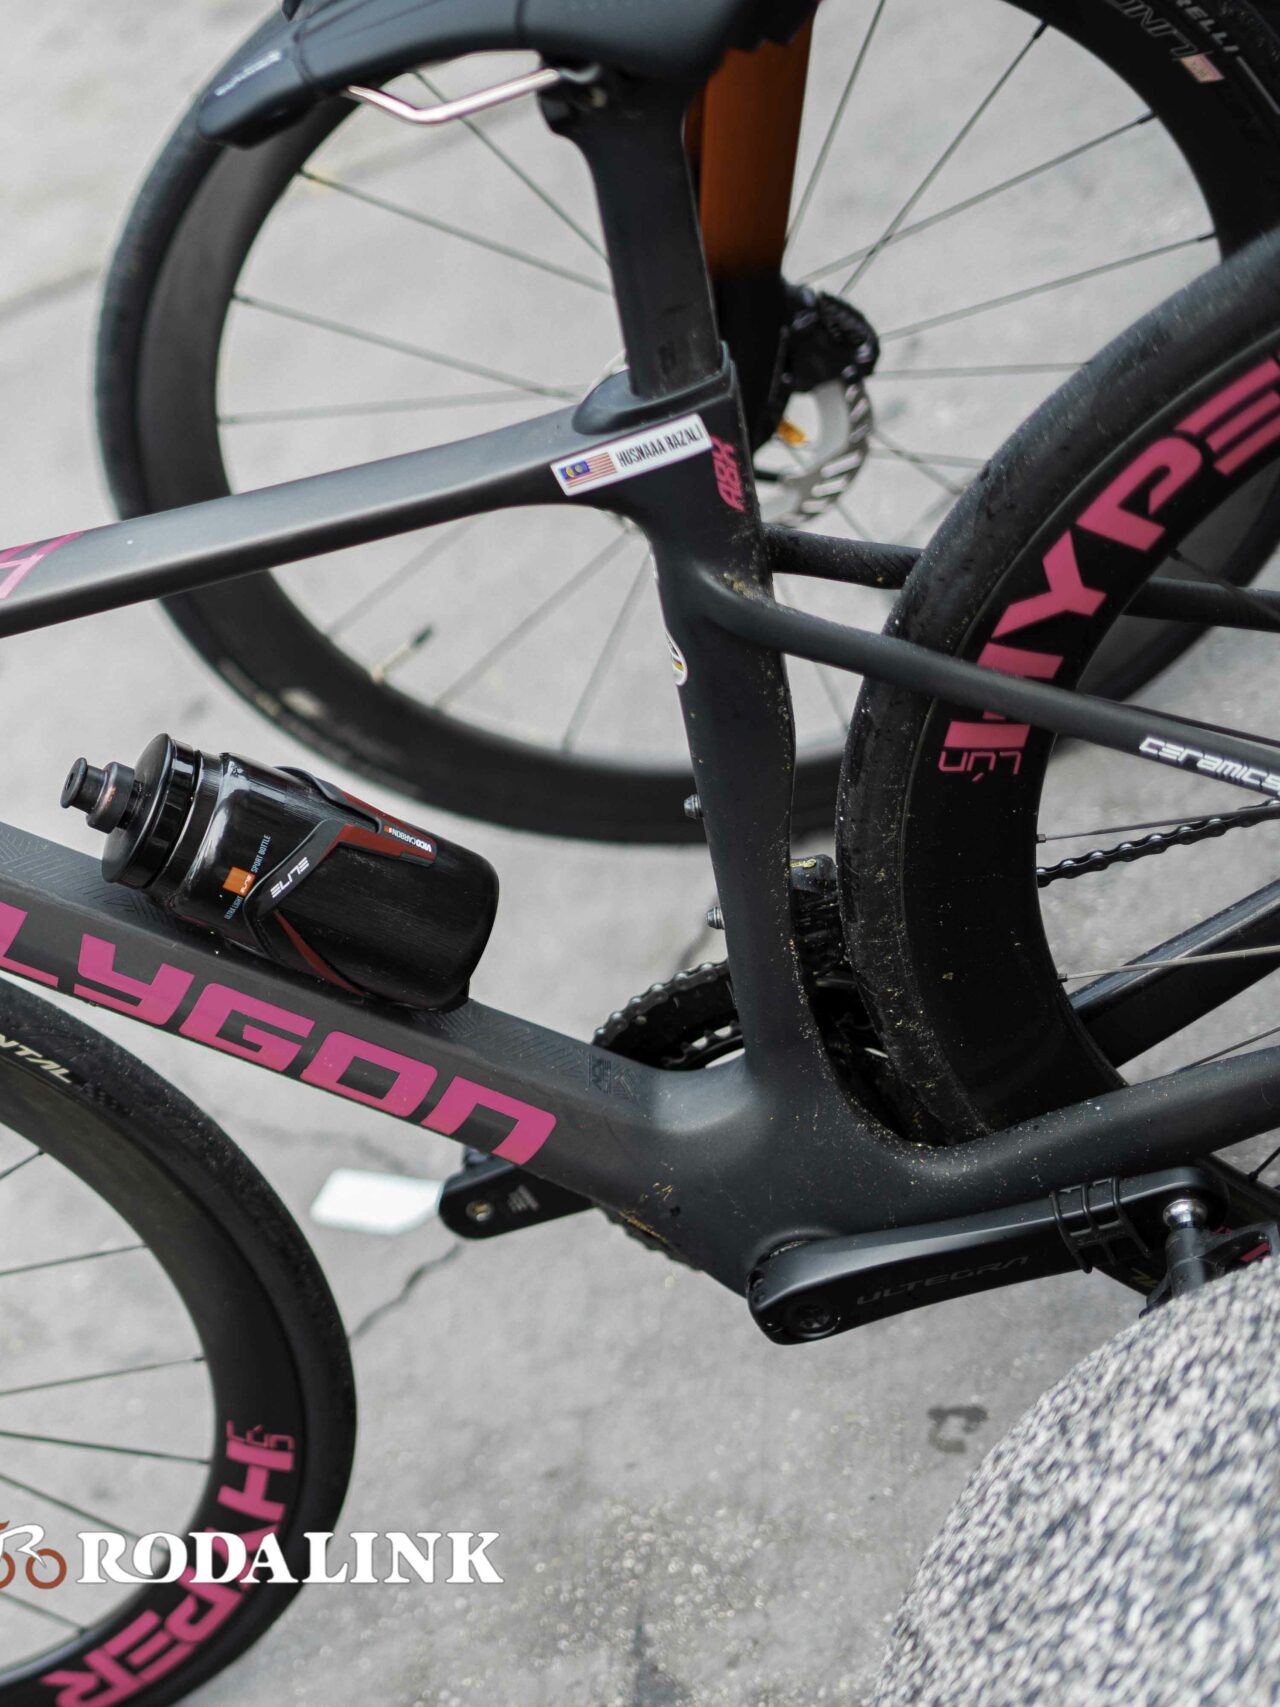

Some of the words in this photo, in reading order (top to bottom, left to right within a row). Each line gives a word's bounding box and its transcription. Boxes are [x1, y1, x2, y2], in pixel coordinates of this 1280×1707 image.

[664, 423, 704, 453] RAZALI
[942, 346, 1280, 749] HYPE
[1138, 736, 1280, 800] ceramics
[250, 854, 263, 874] SPORT
[258, 834, 271, 857] BOTTLE
[269, 856, 310, 899] ELITE
[856, 1254, 1029, 1305] ULTEGRA
